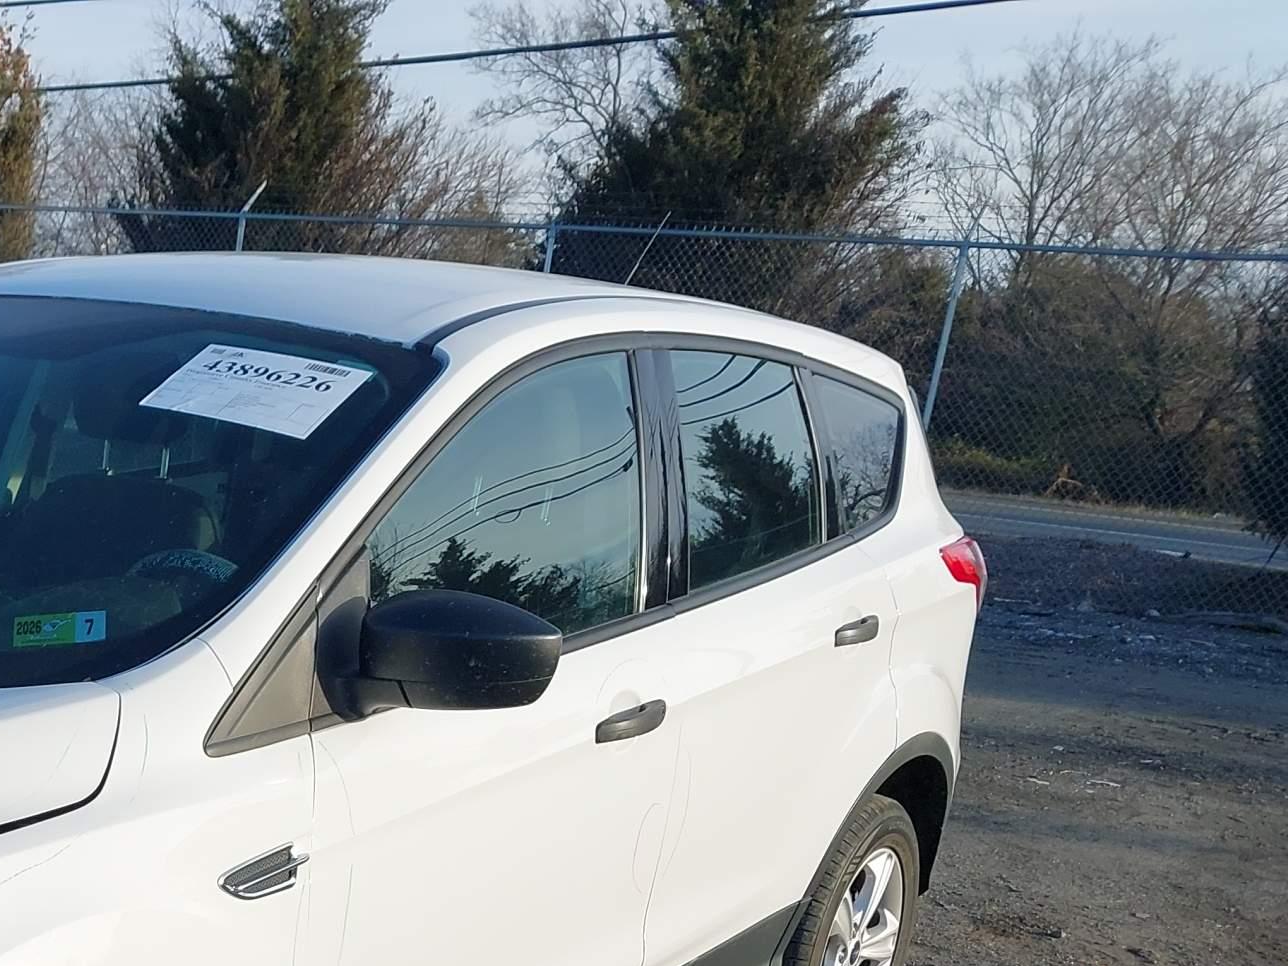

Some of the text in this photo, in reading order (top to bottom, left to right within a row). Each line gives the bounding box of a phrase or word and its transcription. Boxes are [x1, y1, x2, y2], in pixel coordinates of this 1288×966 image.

[202, 359, 336, 393] 43896226
[16, 618, 94, 635] 2026 7
